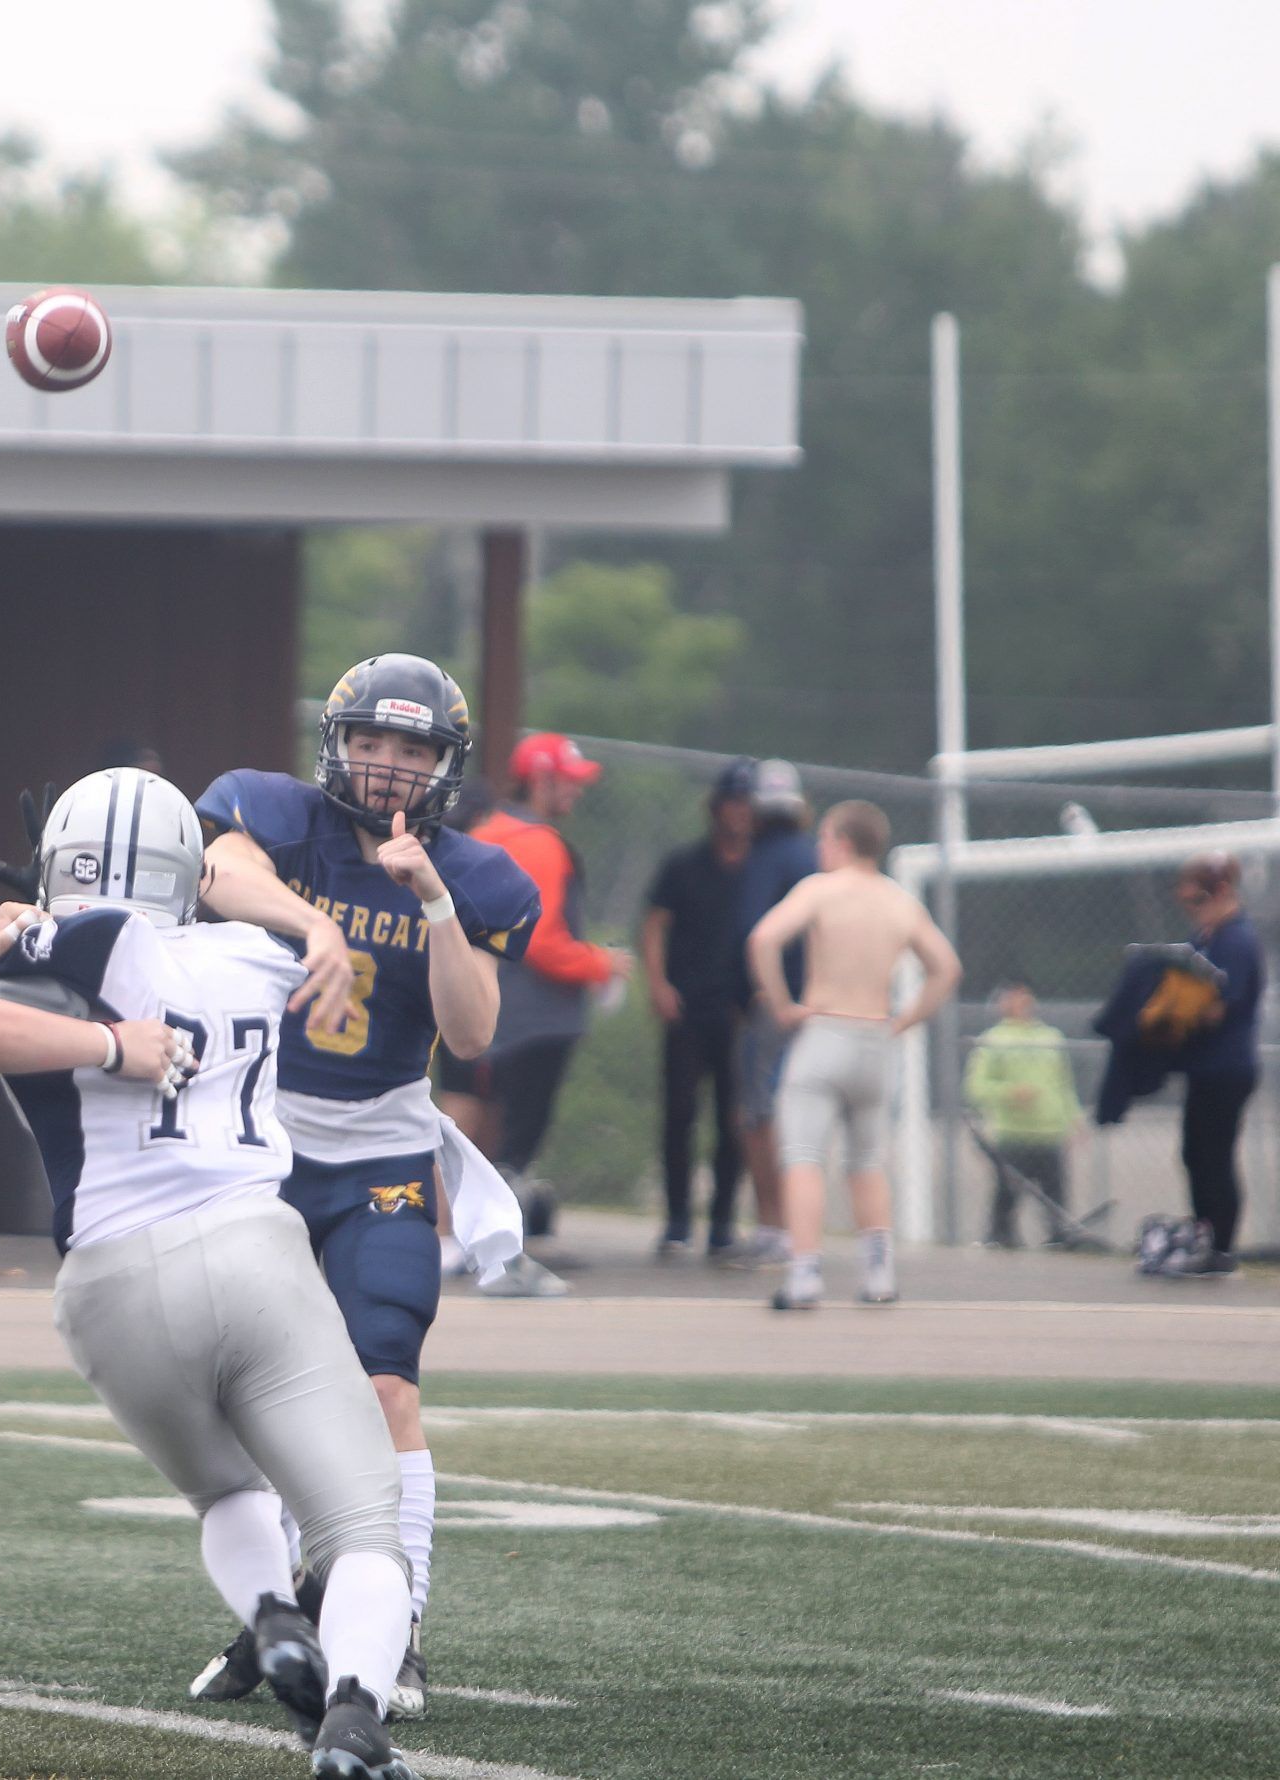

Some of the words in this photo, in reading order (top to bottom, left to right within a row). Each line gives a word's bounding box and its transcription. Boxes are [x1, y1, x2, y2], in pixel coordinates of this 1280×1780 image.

[389, 700, 422, 715] Riddell
[74, 857, 98, 880] 52
[304, 947, 378, 1056] 8
